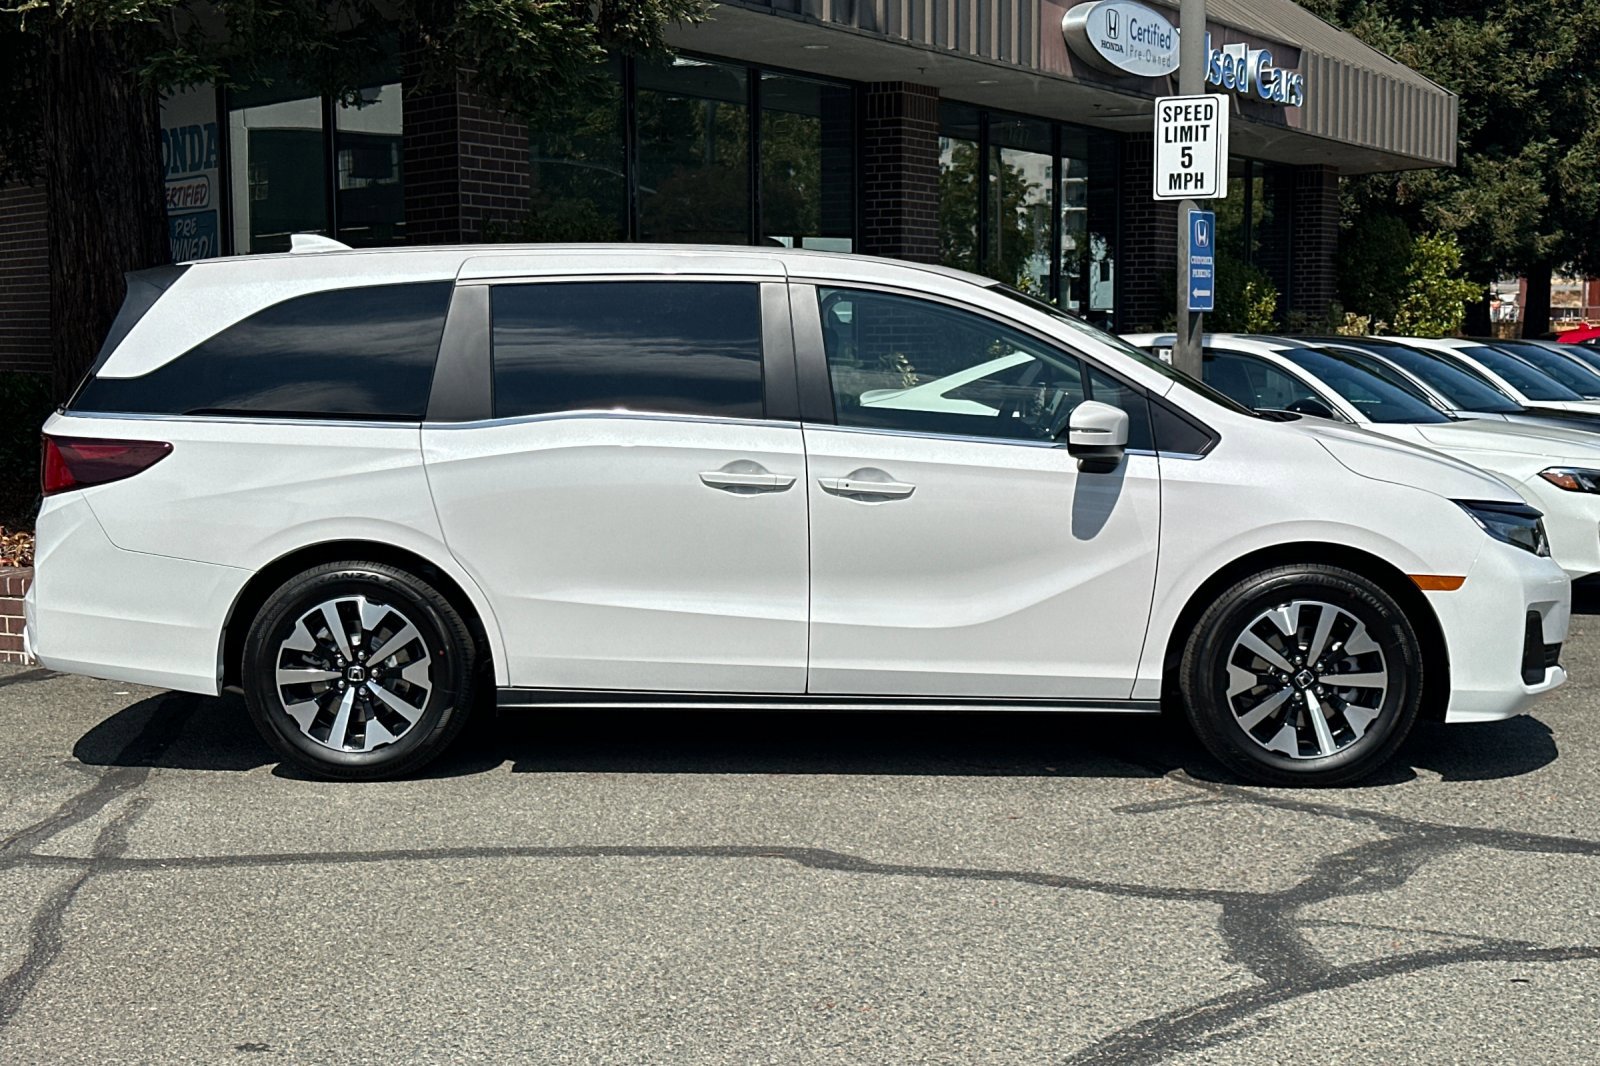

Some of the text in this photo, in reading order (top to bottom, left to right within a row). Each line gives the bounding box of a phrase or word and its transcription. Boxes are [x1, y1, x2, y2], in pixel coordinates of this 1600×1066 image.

[1129, 18, 1171, 50] Certified
[1101, 39, 1124, 54] HONDA
[1130, 44, 1171, 68] Pre-Owned
[1255, 50, 1303, 107] Cars
[1163, 104, 1214, 123] SPEED
[1165, 125, 1210, 143] LIMIT
[161, 122, 220, 174] ONDA
[1181, 147, 1193, 169] 5
[1169, 172, 1204, 190] MPH
[166, 184, 207, 207] ERTIFIED
[170, 232, 214, 262] WNED!
